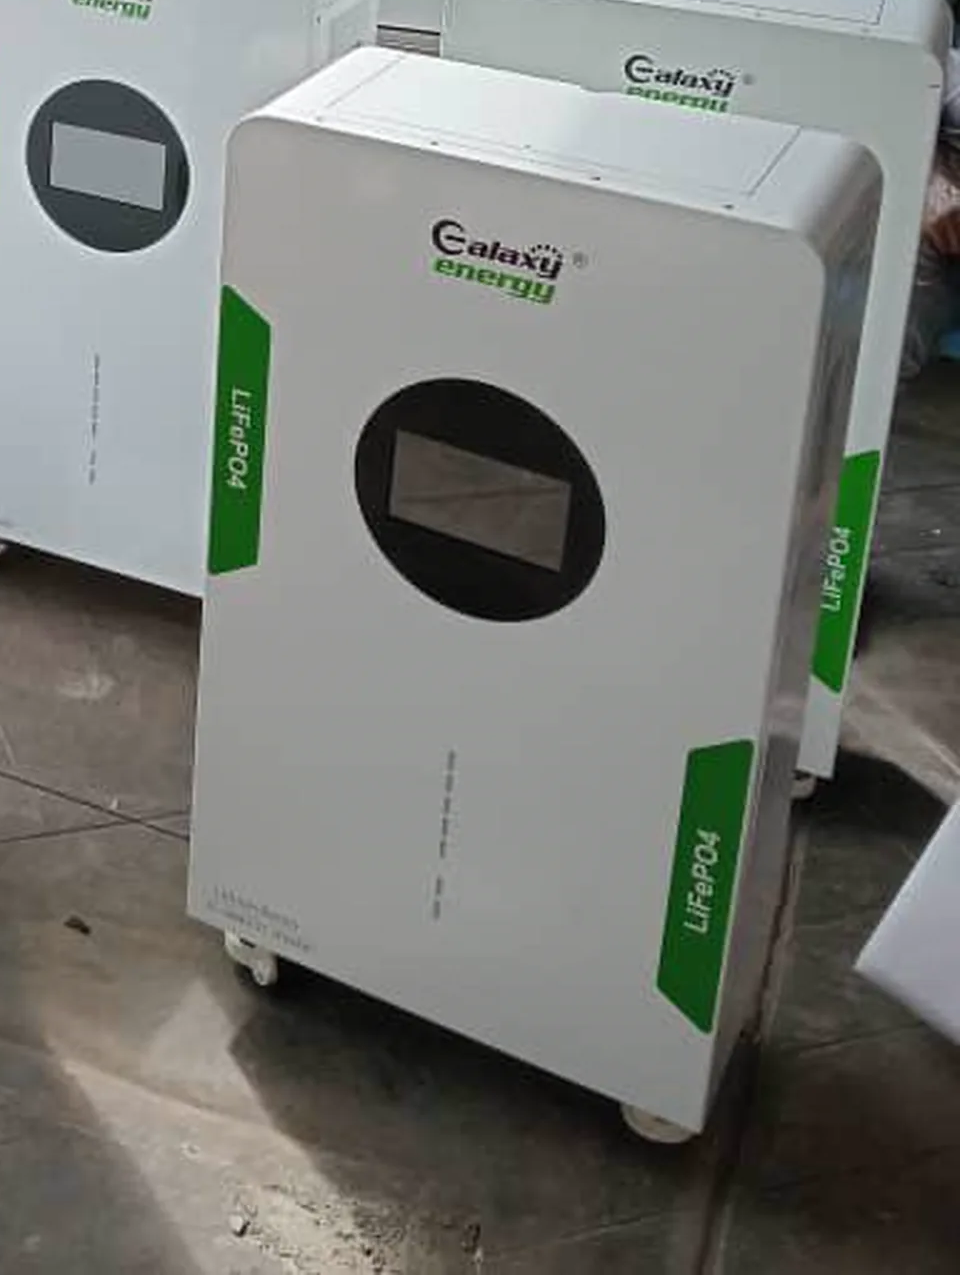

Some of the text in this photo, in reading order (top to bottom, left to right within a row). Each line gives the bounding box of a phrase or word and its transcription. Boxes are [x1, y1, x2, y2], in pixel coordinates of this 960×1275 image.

[625, 54, 736, 97] Galaxy
[432, 219, 563, 279] Galaxy
[434, 257, 555, 304] energy
[683, 828, 721, 933] LiFePO4
